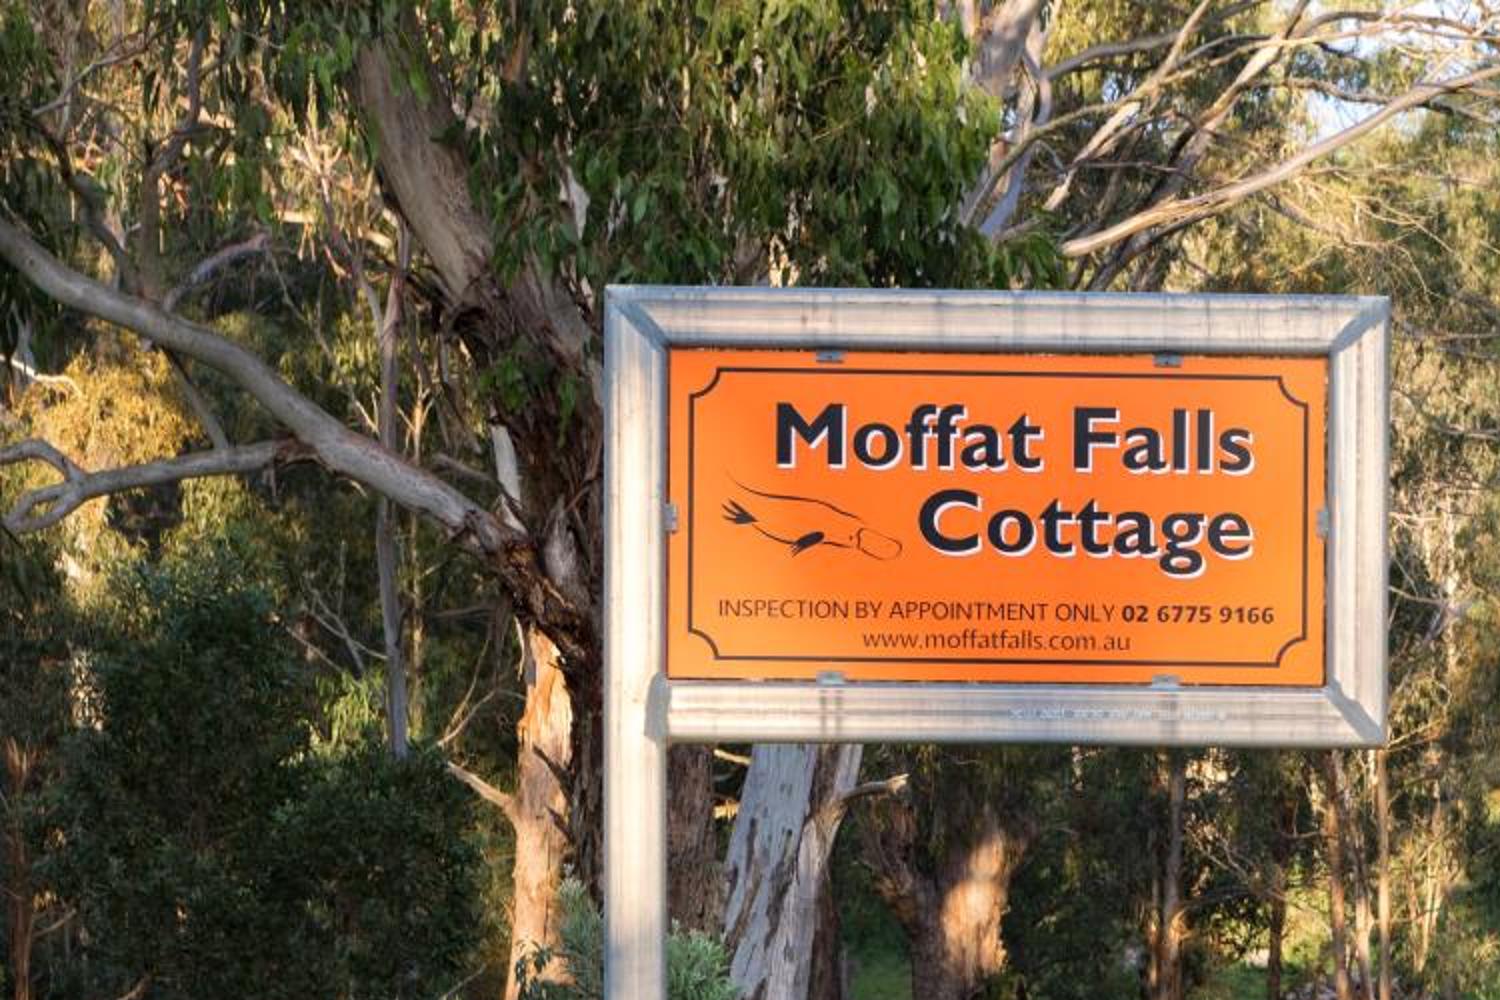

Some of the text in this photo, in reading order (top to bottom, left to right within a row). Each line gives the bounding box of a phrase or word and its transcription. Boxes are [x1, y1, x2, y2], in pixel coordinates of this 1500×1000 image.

[775, 402, 1253, 473] Moffat Falls
[917, 488, 1252, 576] Cottage
[719, 600, 1275, 625] INSPECTION BY APPOINTMENT ONLY 02 6775 9166
[862, 628, 1131, 651] www.moffatfalls.com.au
